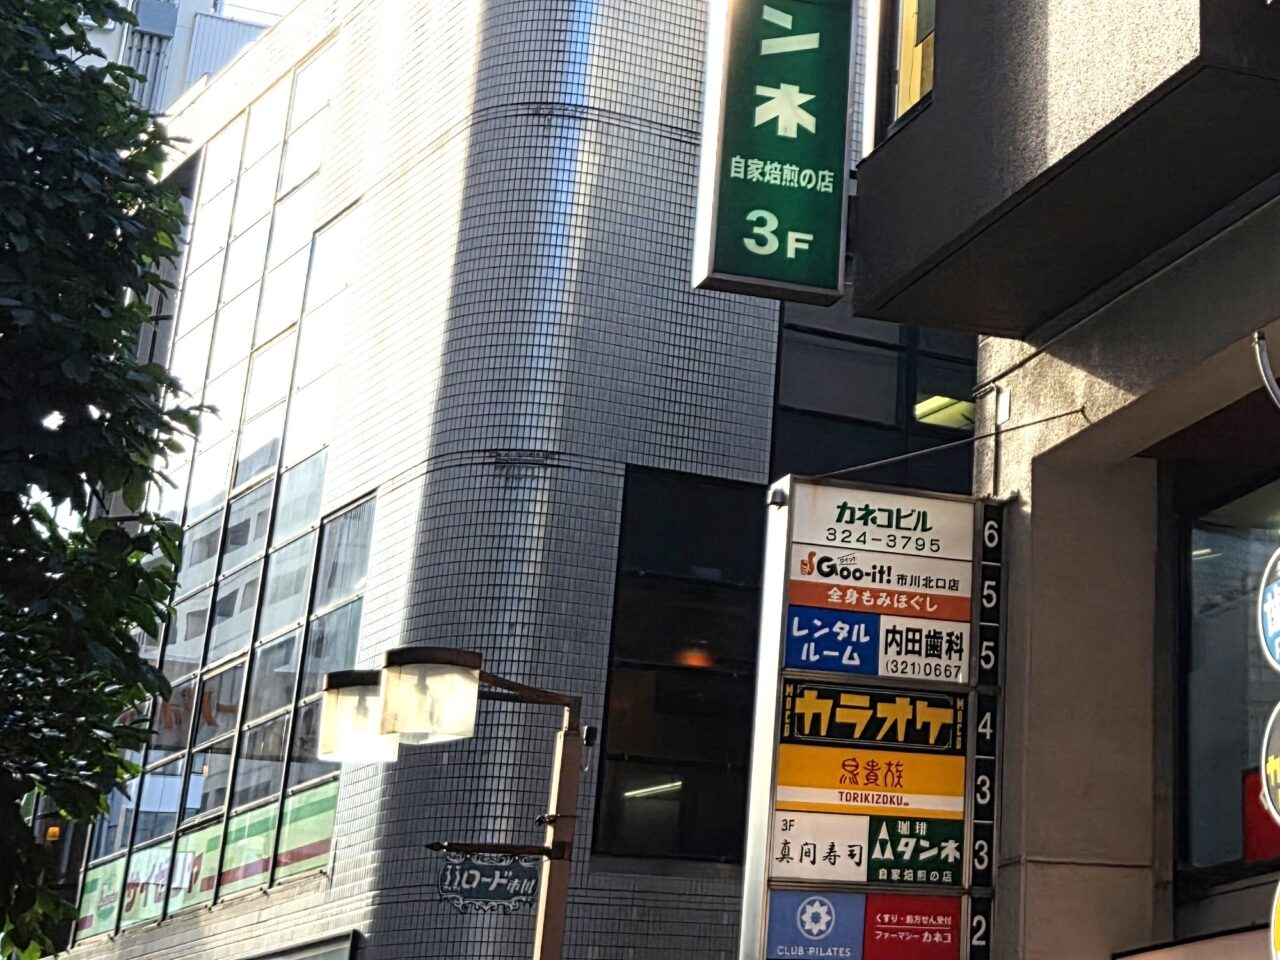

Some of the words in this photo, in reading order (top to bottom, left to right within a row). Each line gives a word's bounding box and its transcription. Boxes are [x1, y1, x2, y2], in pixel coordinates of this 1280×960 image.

[729, 155, 835, 192] 自家焙煎の店
[742, 209, 814, 259] 3F
[835, 500, 933, 532] カネコビル
[826, 527, 941, 553] 324-3795
[984, 520, 999, 548] 6
[816, 555, 892, 584] Goo-it!
[896, 573, 960, 591] 市川北口店
[828, 587, 938, 612] 全身もみほぐし
[982, 580, 997, 608] 5
[793, 616, 870, 643] レンタル
[884, 625, 964, 661] 内田歯科
[801, 642, 861, 666] ルーム
[980, 641, 995, 669] 5
[886, 659, 961, 679] (321)0667
[795, 689, 954, 744] カラオケ
[978, 711, 993, 739] 4
[838, 791, 903, 806] TORIKIZOKU
[976, 775, 991, 804] 3
[781, 818, 795, 832] 3F
[897, 820, 927, 835] 珈琲
[775, 839, 864, 867] 真間寿司
[897, 837, 960, 863] タンネ
[974, 840, 988, 870] 3
[878, 869, 952, 882] 自家焙煎の店
[971, 916, 987, 945] 2
[777, 945, 803, 956] CLUB
[809, 946, 851, 957] PILATES
